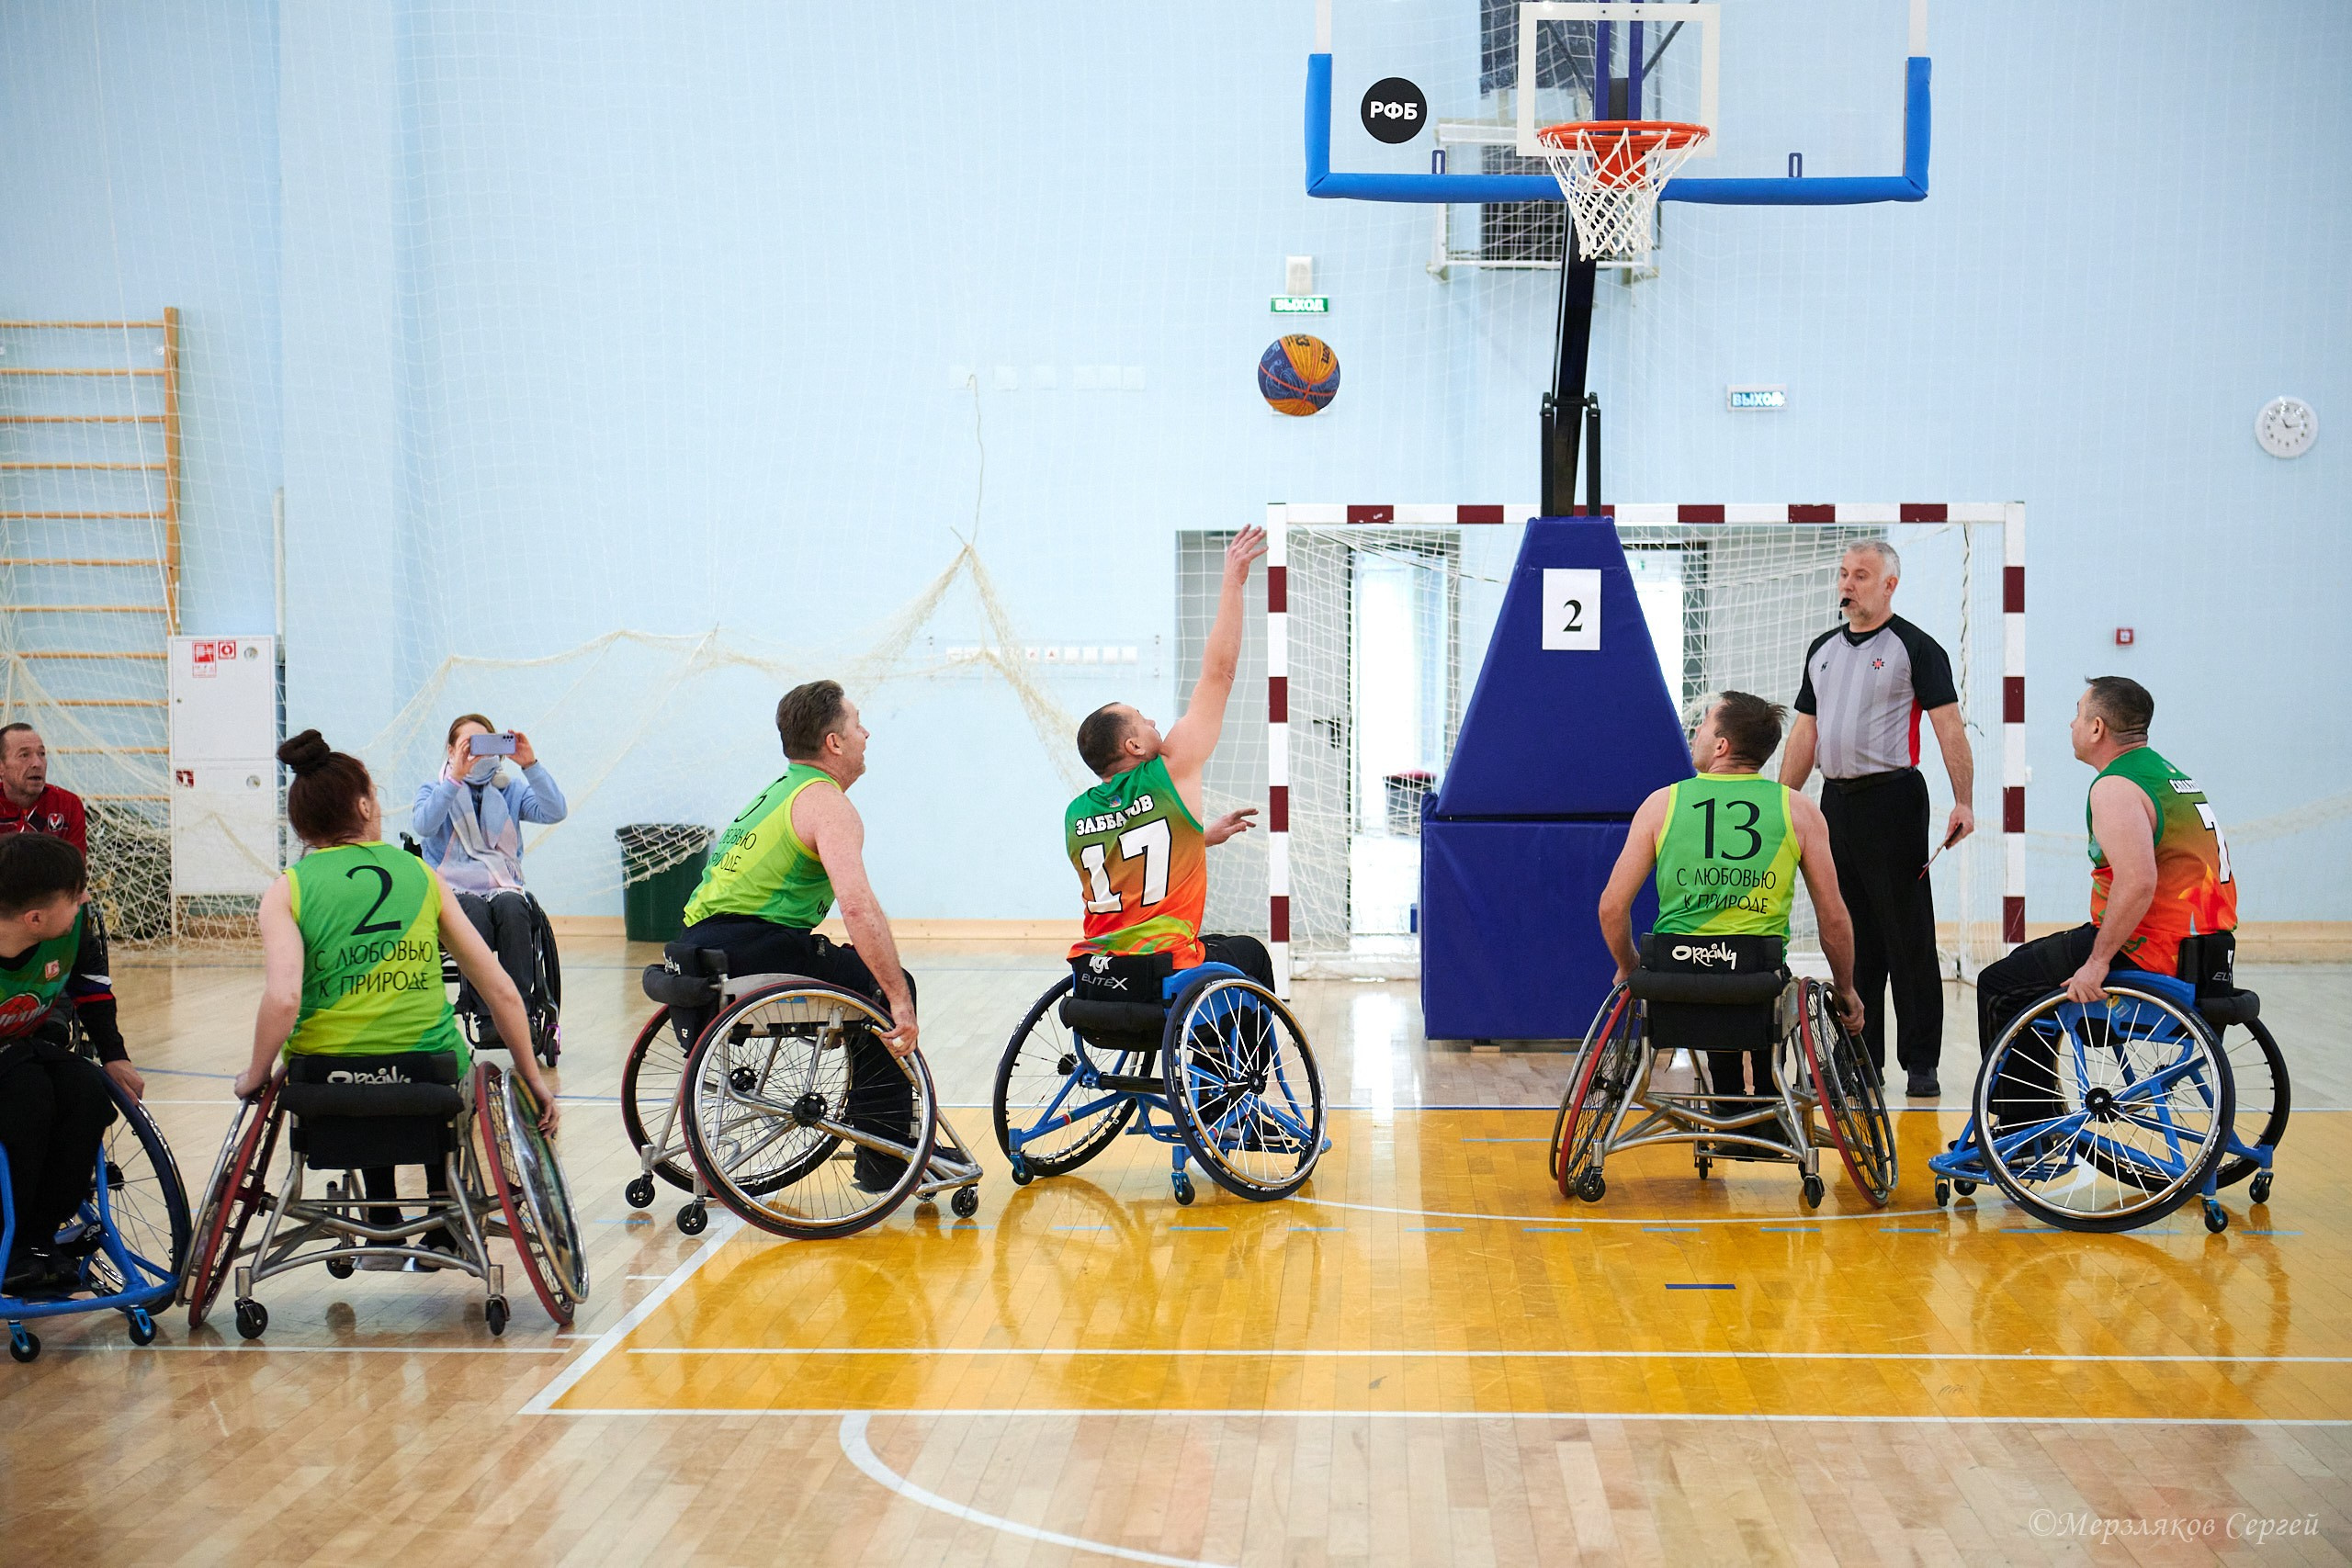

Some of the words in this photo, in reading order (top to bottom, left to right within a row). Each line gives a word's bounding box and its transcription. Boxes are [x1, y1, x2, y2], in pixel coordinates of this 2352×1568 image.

[1370, 101, 1418, 120] РФБ
[1274, 298, 1325, 312] ВЫХОД
[1563, 599, 1583, 632] 2
[1691, 797, 1762, 861] 13
[2192, 801, 2232, 885] 7
[1080, 816, 1172, 915] 17
[1677, 868, 1687, 886] С
[1694, 867, 1776, 889] ЛЮБОВЬЮ
[345, 864, 401, 936] 2
[1697, 893, 1769, 915] ПРИРОДЕ
[314, 950, 325, 972] С
[336, 940, 433, 970] ЛЮБОВЬЮ
[319, 978, 329, 998] К
[340, 970, 429, 997] ПРИРОДЕ
[1081, 973, 1128, 991] ELITEX
